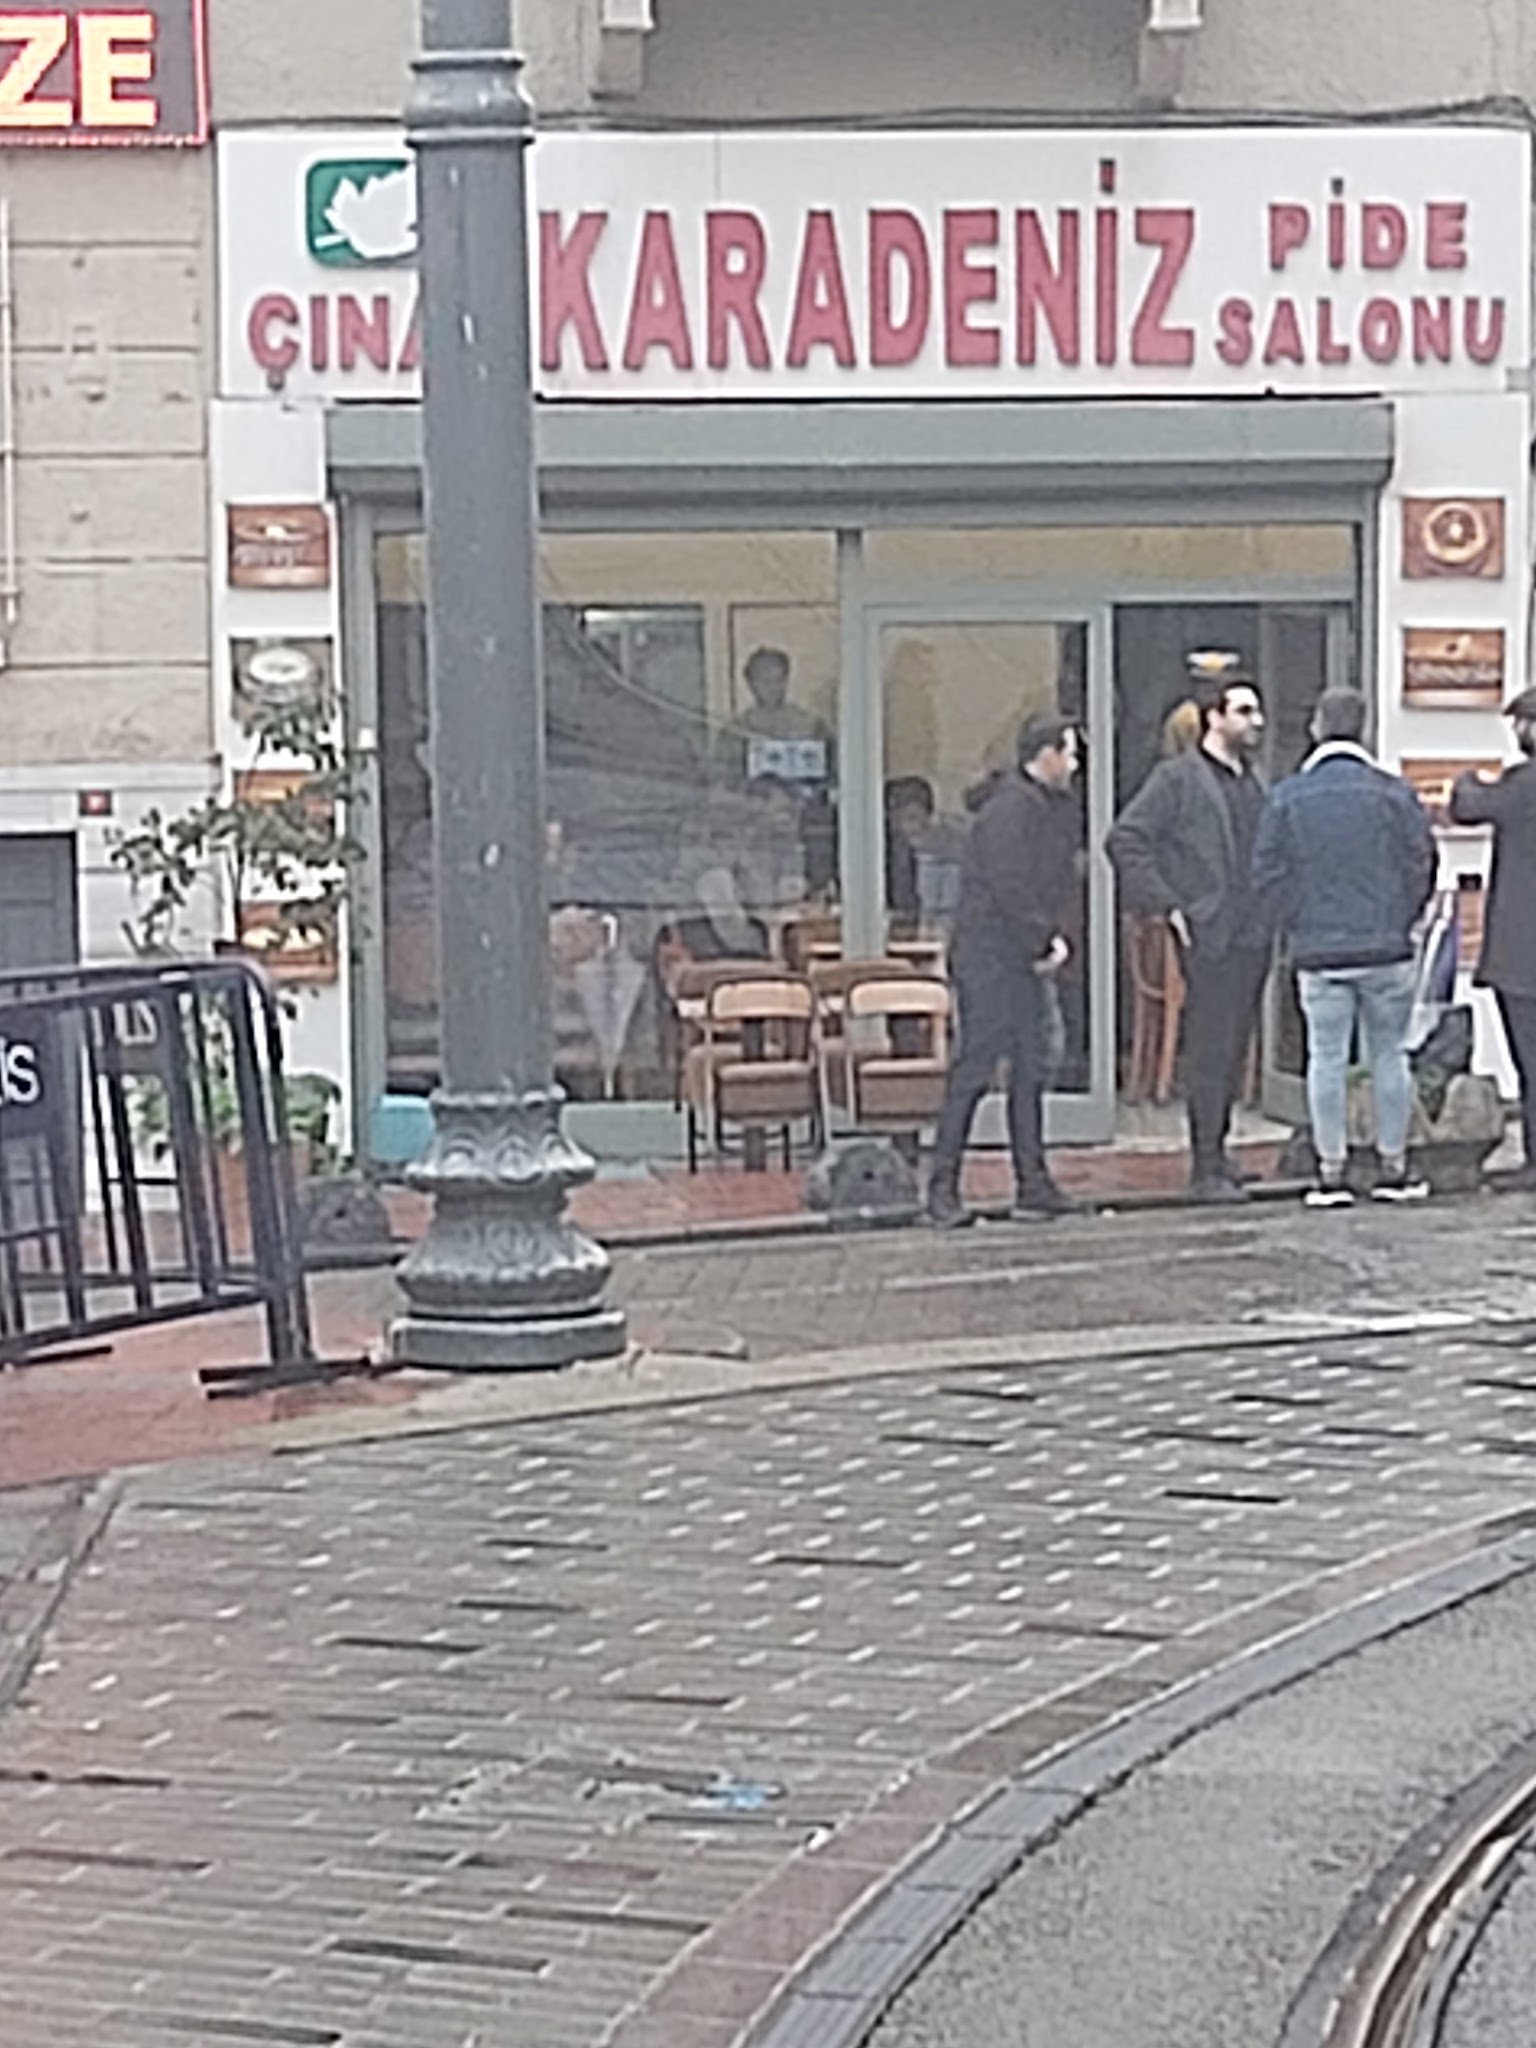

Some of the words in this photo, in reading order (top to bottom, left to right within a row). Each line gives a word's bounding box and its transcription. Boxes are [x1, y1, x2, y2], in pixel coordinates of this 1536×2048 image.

[1268, 177, 1468, 271] PİDE
[247, 293, 422, 392] ÇIN
[539, 158, 1195, 369] KARADENİZ
[1215, 296, 1506, 366] SALONU
